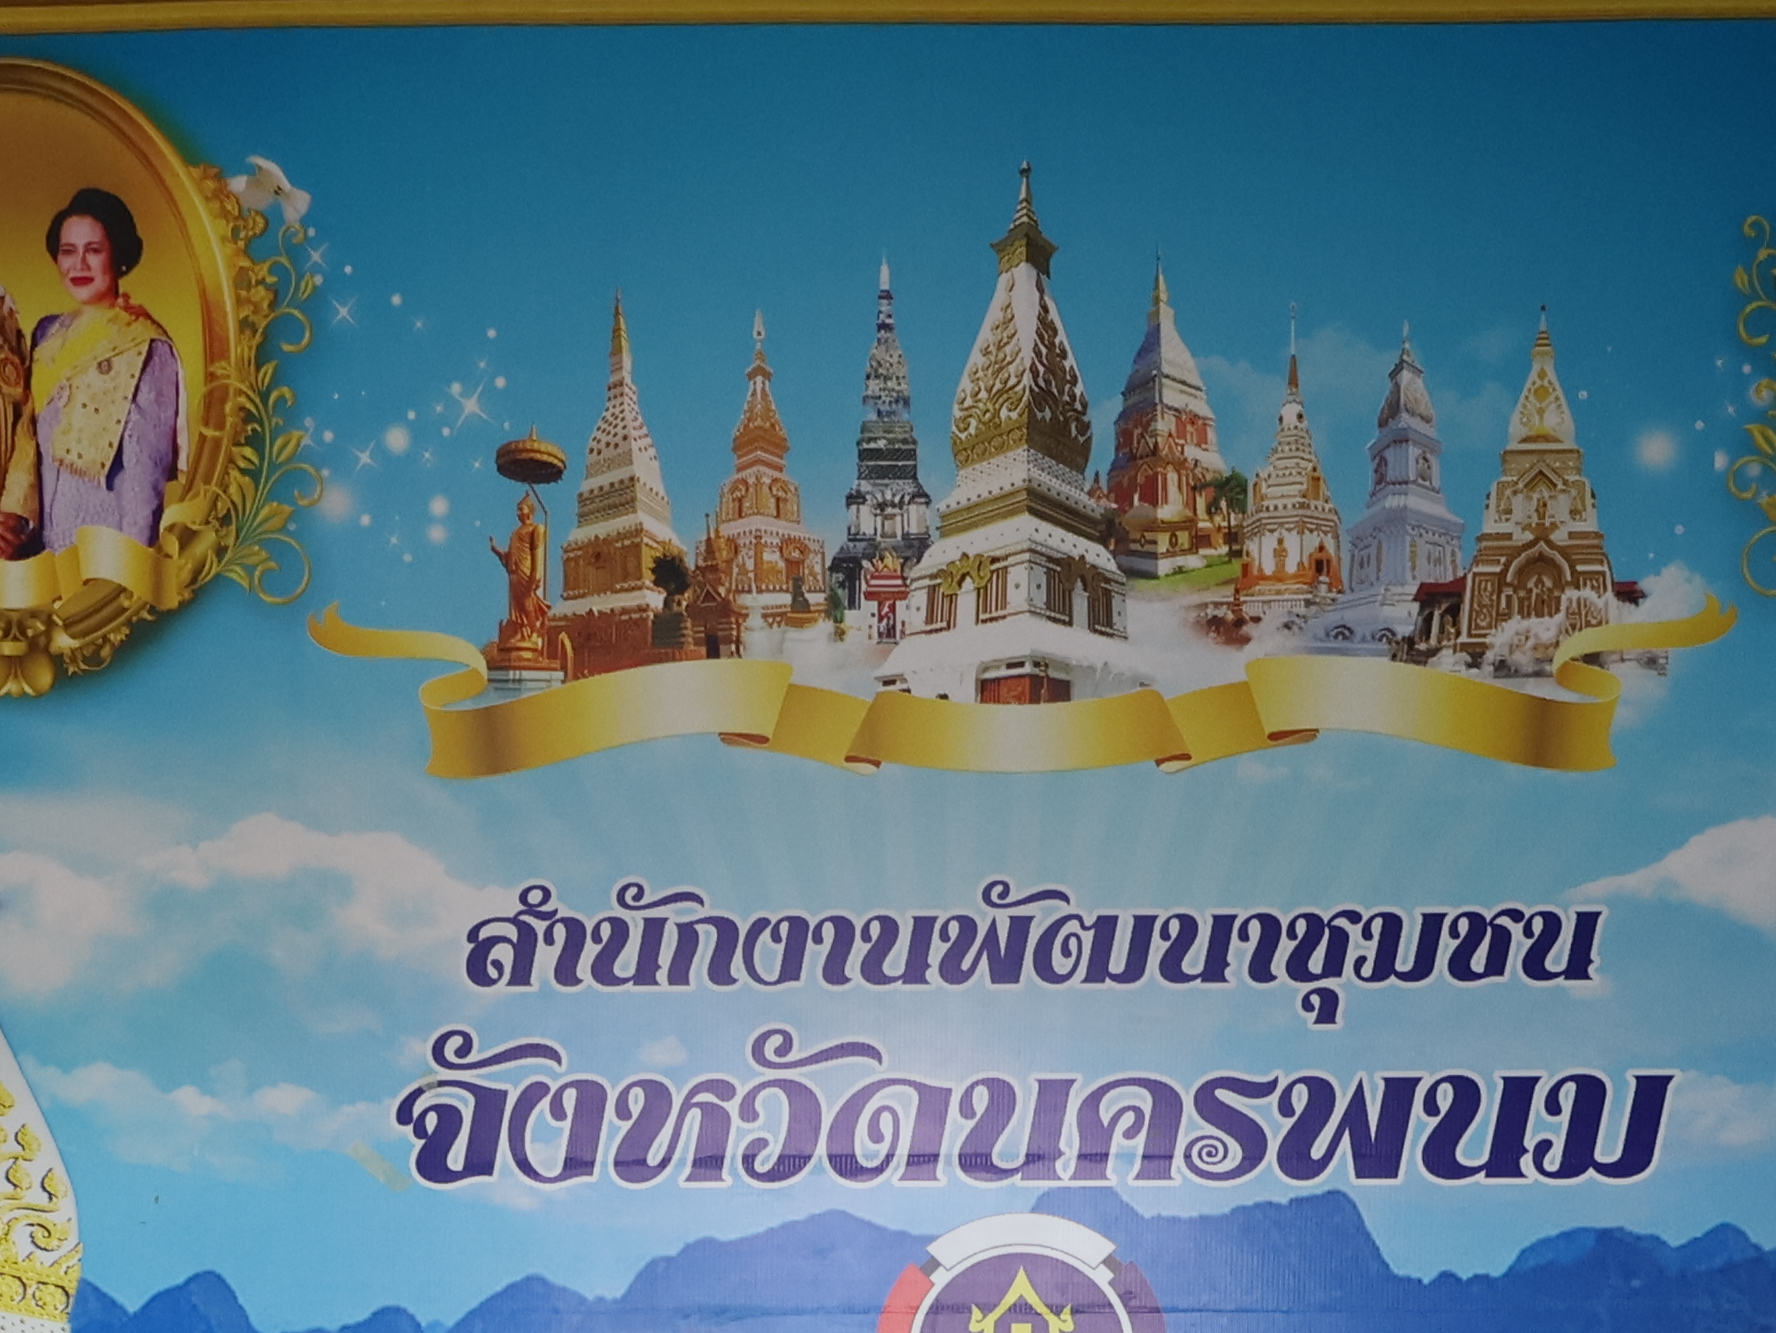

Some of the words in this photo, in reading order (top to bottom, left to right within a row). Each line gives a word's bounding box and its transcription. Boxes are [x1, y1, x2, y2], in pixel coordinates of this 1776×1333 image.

[465, 880, 1603, 1027] สำนักงานพัฒนาชุมชน
[395, 1027, 1678, 1188] จังหวัดนครพนม
